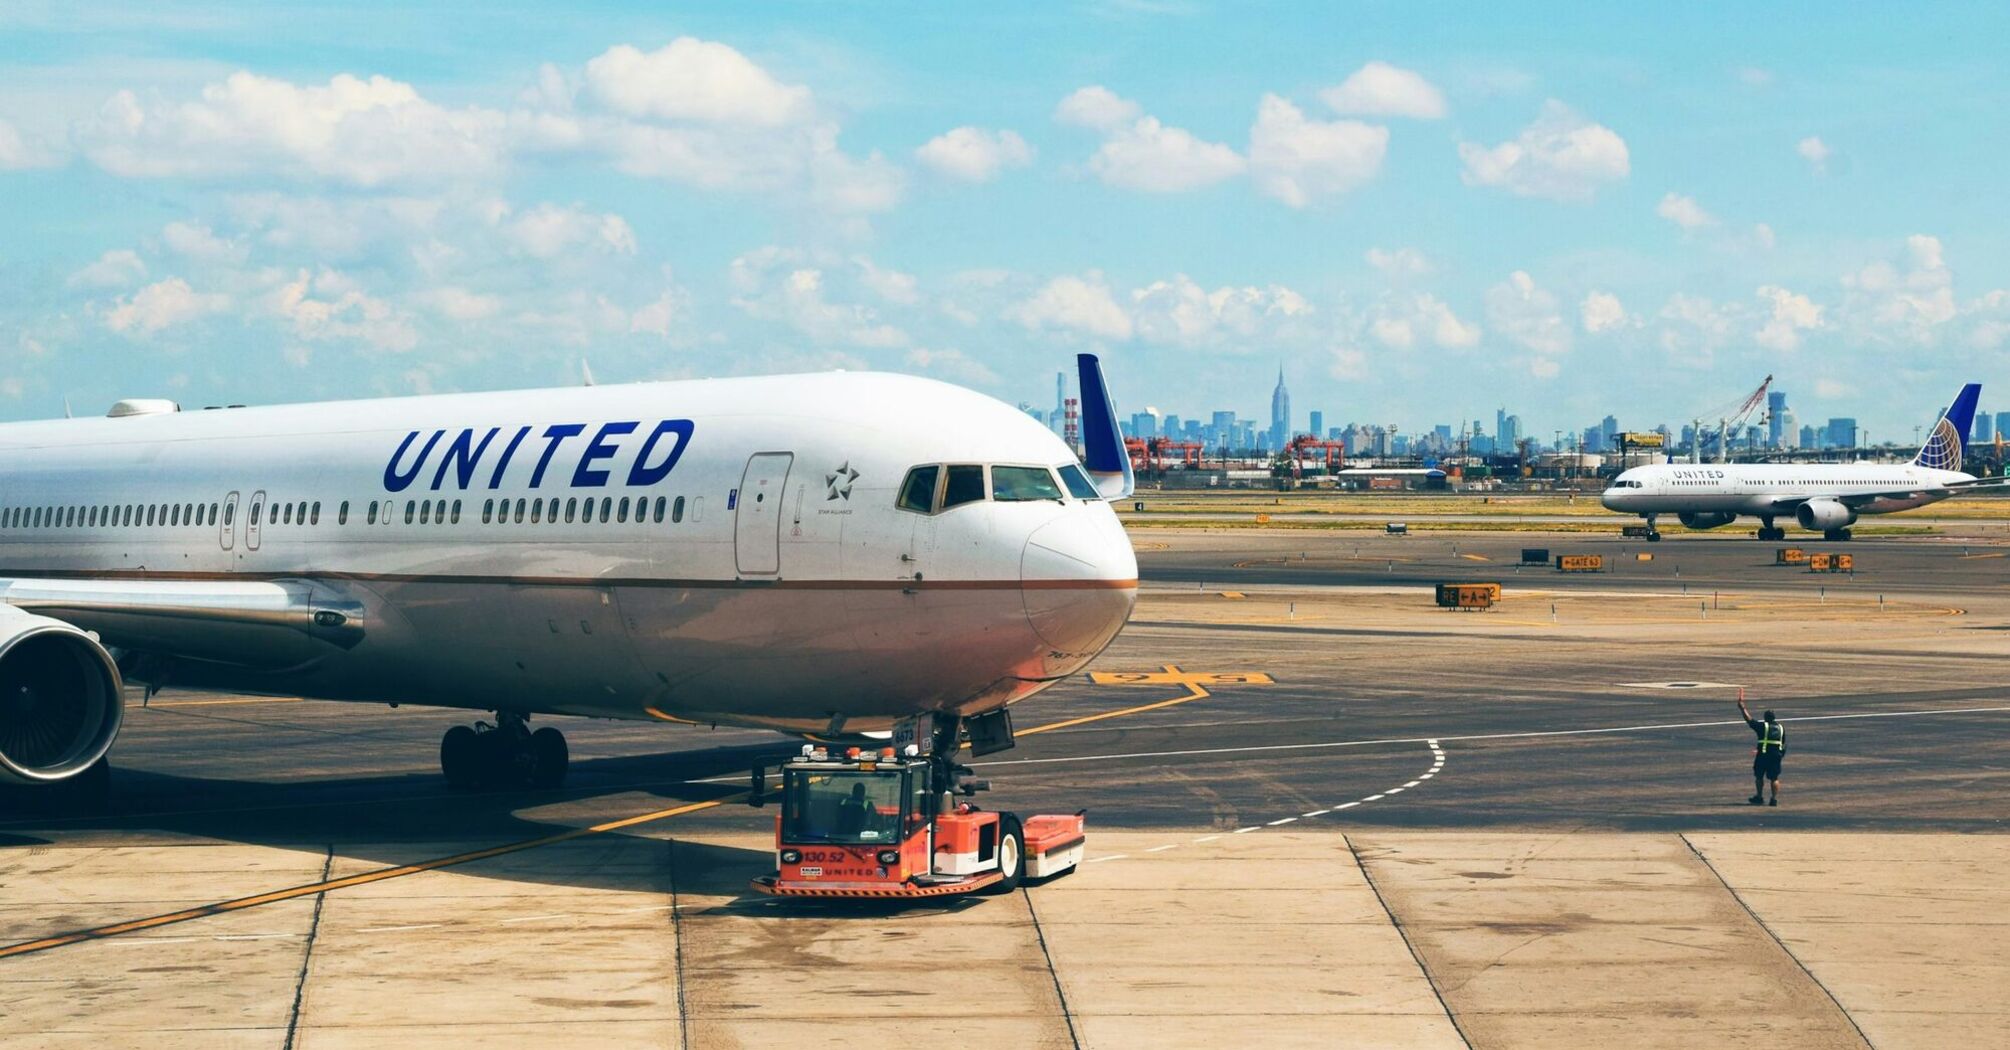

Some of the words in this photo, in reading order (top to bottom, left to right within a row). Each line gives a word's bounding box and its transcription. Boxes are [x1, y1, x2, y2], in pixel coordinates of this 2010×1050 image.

[384, 419, 695, 492] UNITED
[1673, 470, 1724, 479] UNITED
[1571, 558, 1587, 566] GATE
[1589, 558, 1599, 566] 63
[1470, 591, 1477, 603] A
[825, 868, 873, 876] UNITED
